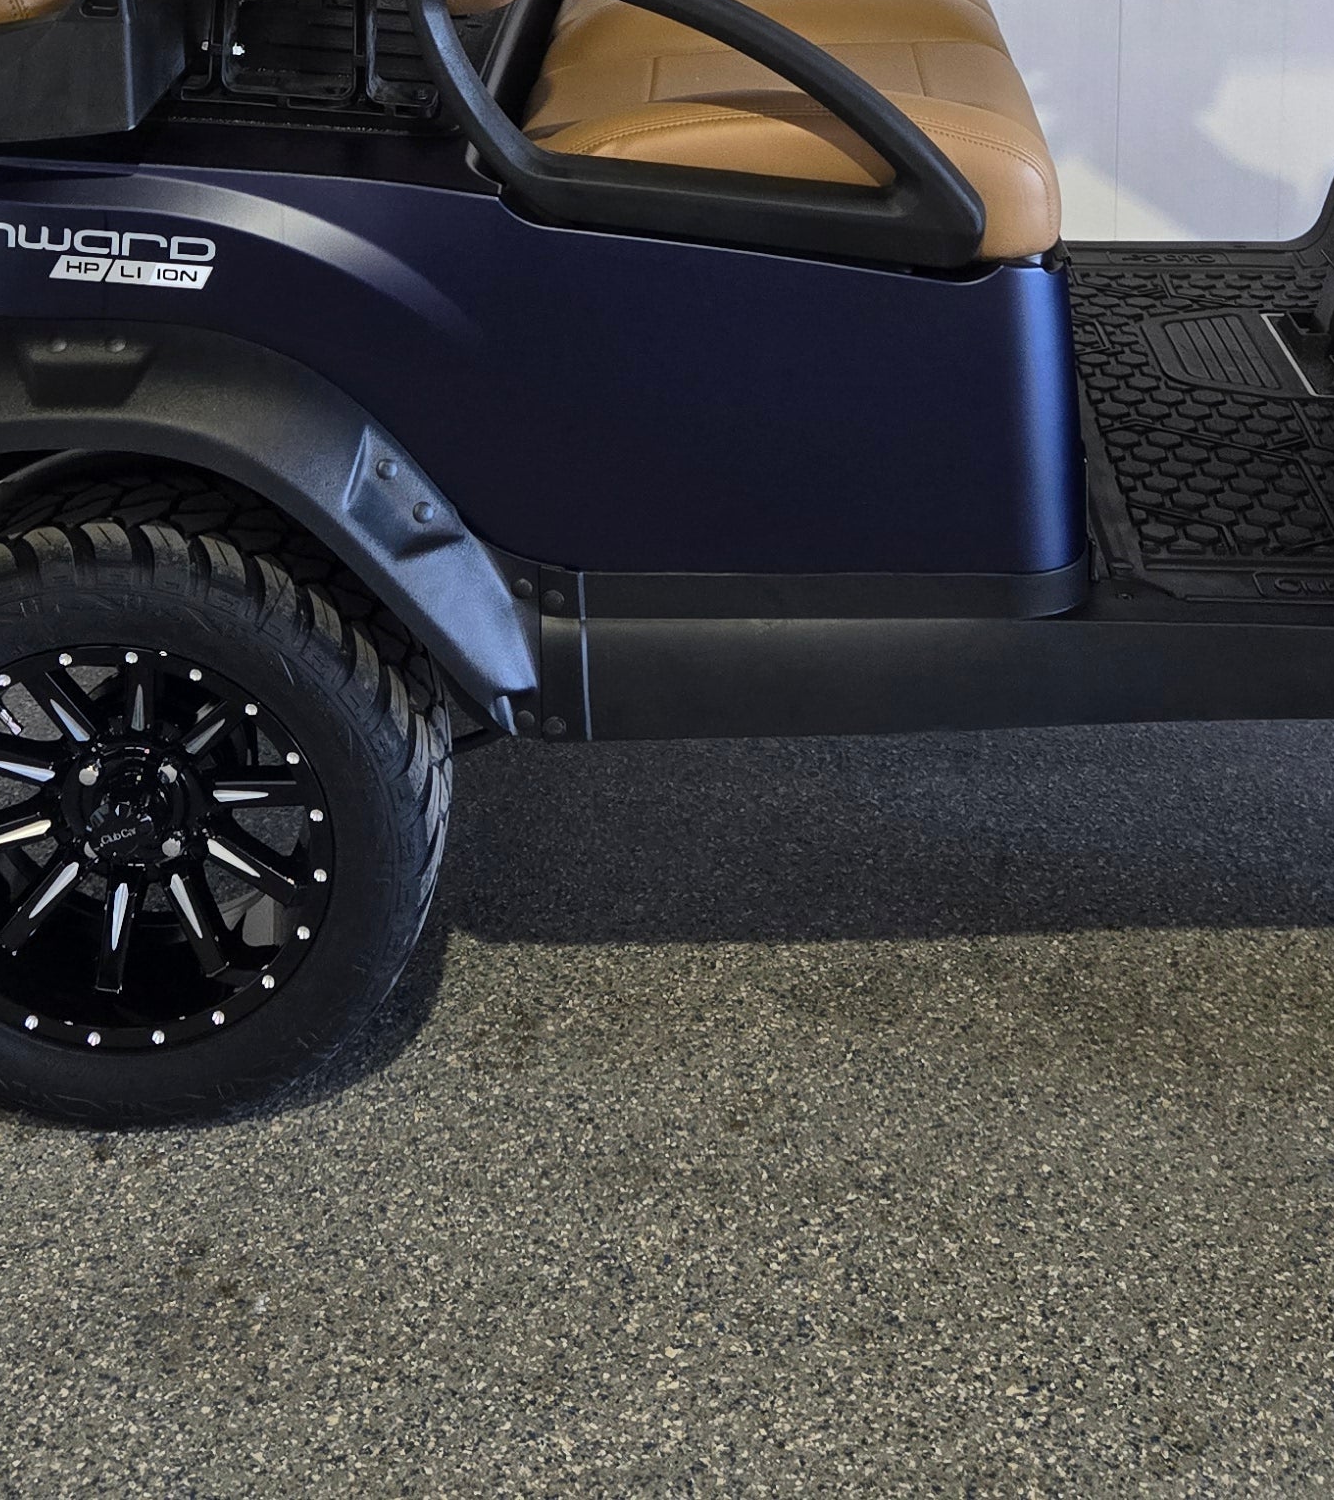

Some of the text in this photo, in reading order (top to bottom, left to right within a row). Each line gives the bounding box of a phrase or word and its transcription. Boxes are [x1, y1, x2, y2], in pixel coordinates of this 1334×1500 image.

[156, 268, 198, 283] ION
[100, 827, 137, 845] Club Car
